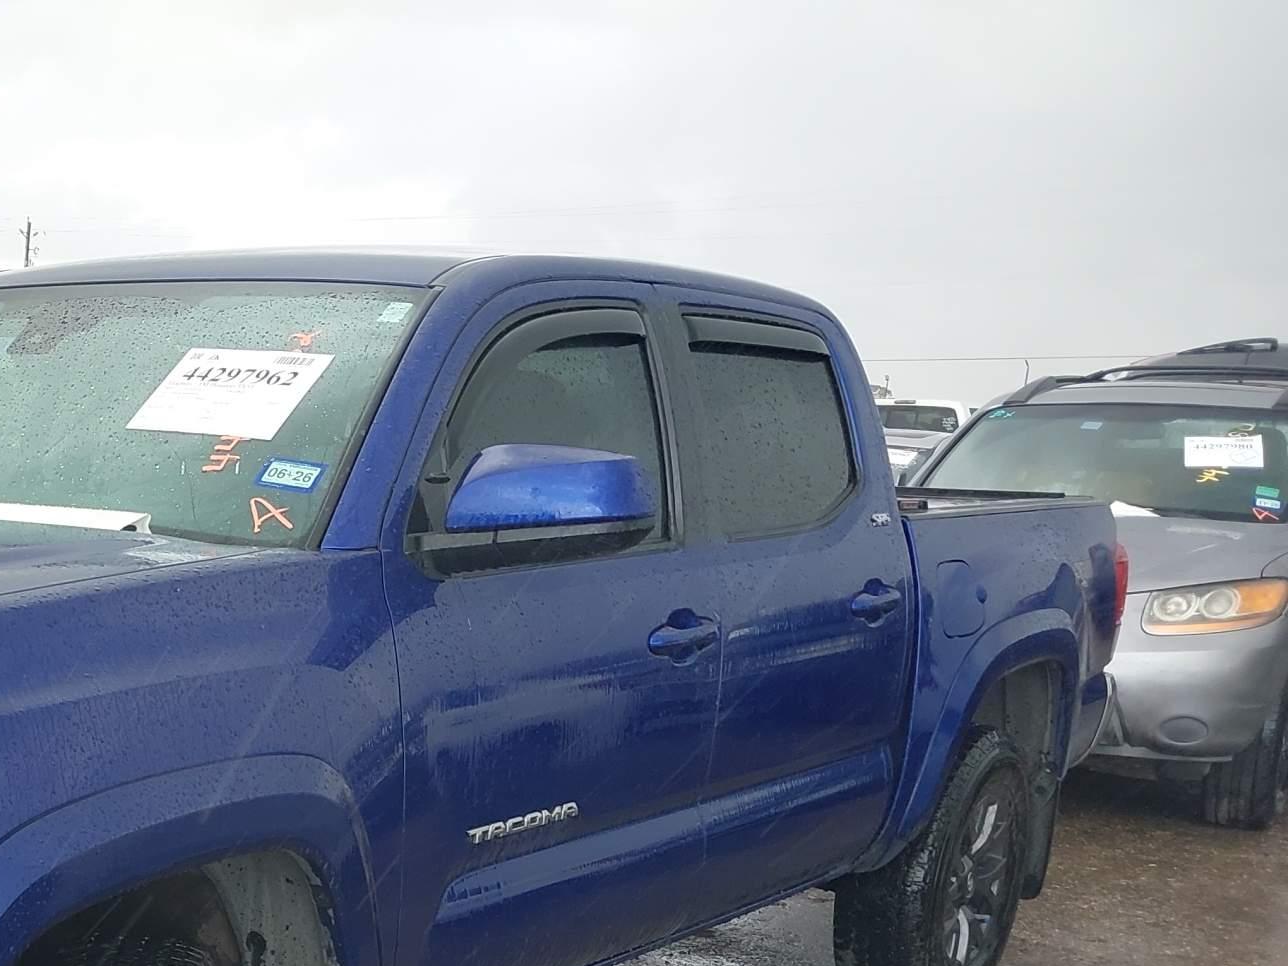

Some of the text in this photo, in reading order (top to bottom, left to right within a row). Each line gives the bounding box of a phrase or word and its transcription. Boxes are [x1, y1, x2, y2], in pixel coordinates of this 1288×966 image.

[182, 366, 300, 387] 44297962
[250, 497, 294, 533] A
[467, 802, 579, 844] TACOMA
